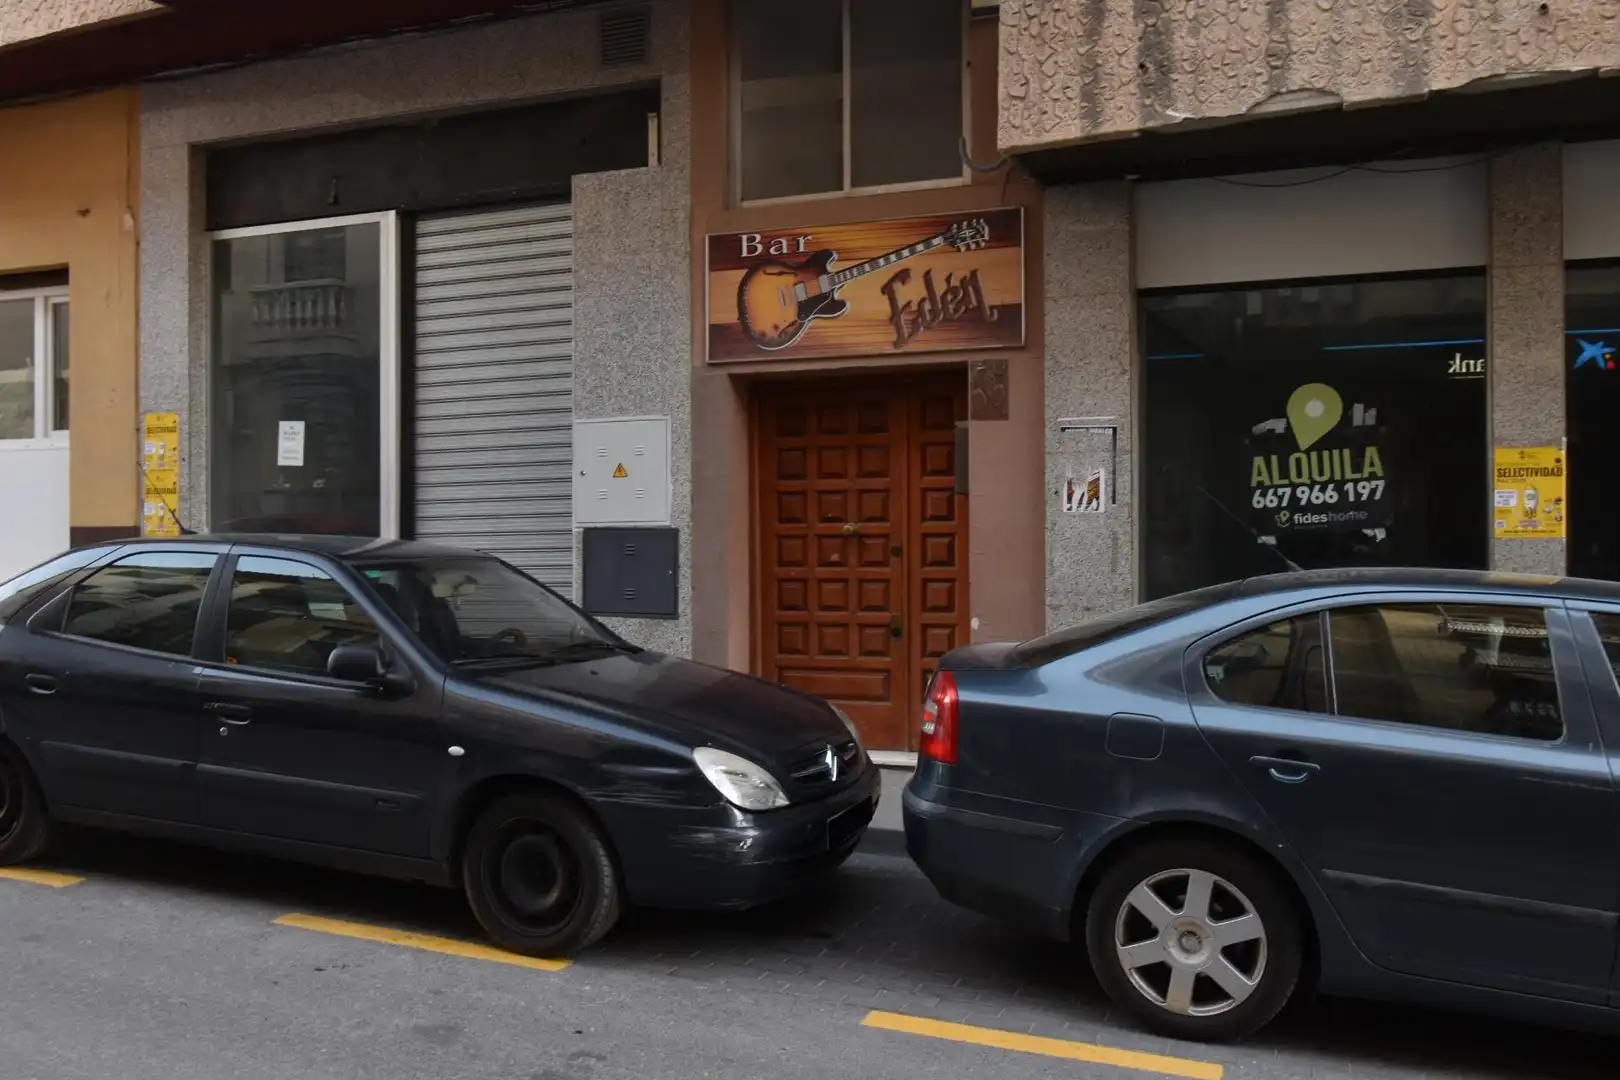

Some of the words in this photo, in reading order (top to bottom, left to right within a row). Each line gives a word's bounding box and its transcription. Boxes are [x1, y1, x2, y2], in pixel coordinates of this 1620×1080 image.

[739, 233, 813, 258] Bar
[1250, 446, 1384, 487] ALQUILA
[1496, 467, 1563, 478] SELECTIVIDAD
[1252, 487, 1292, 509] 667
[1295, 483, 1339, 506] 966
[1343, 480, 1386, 502] 197
[1293, 510, 1369, 524] fideshome
